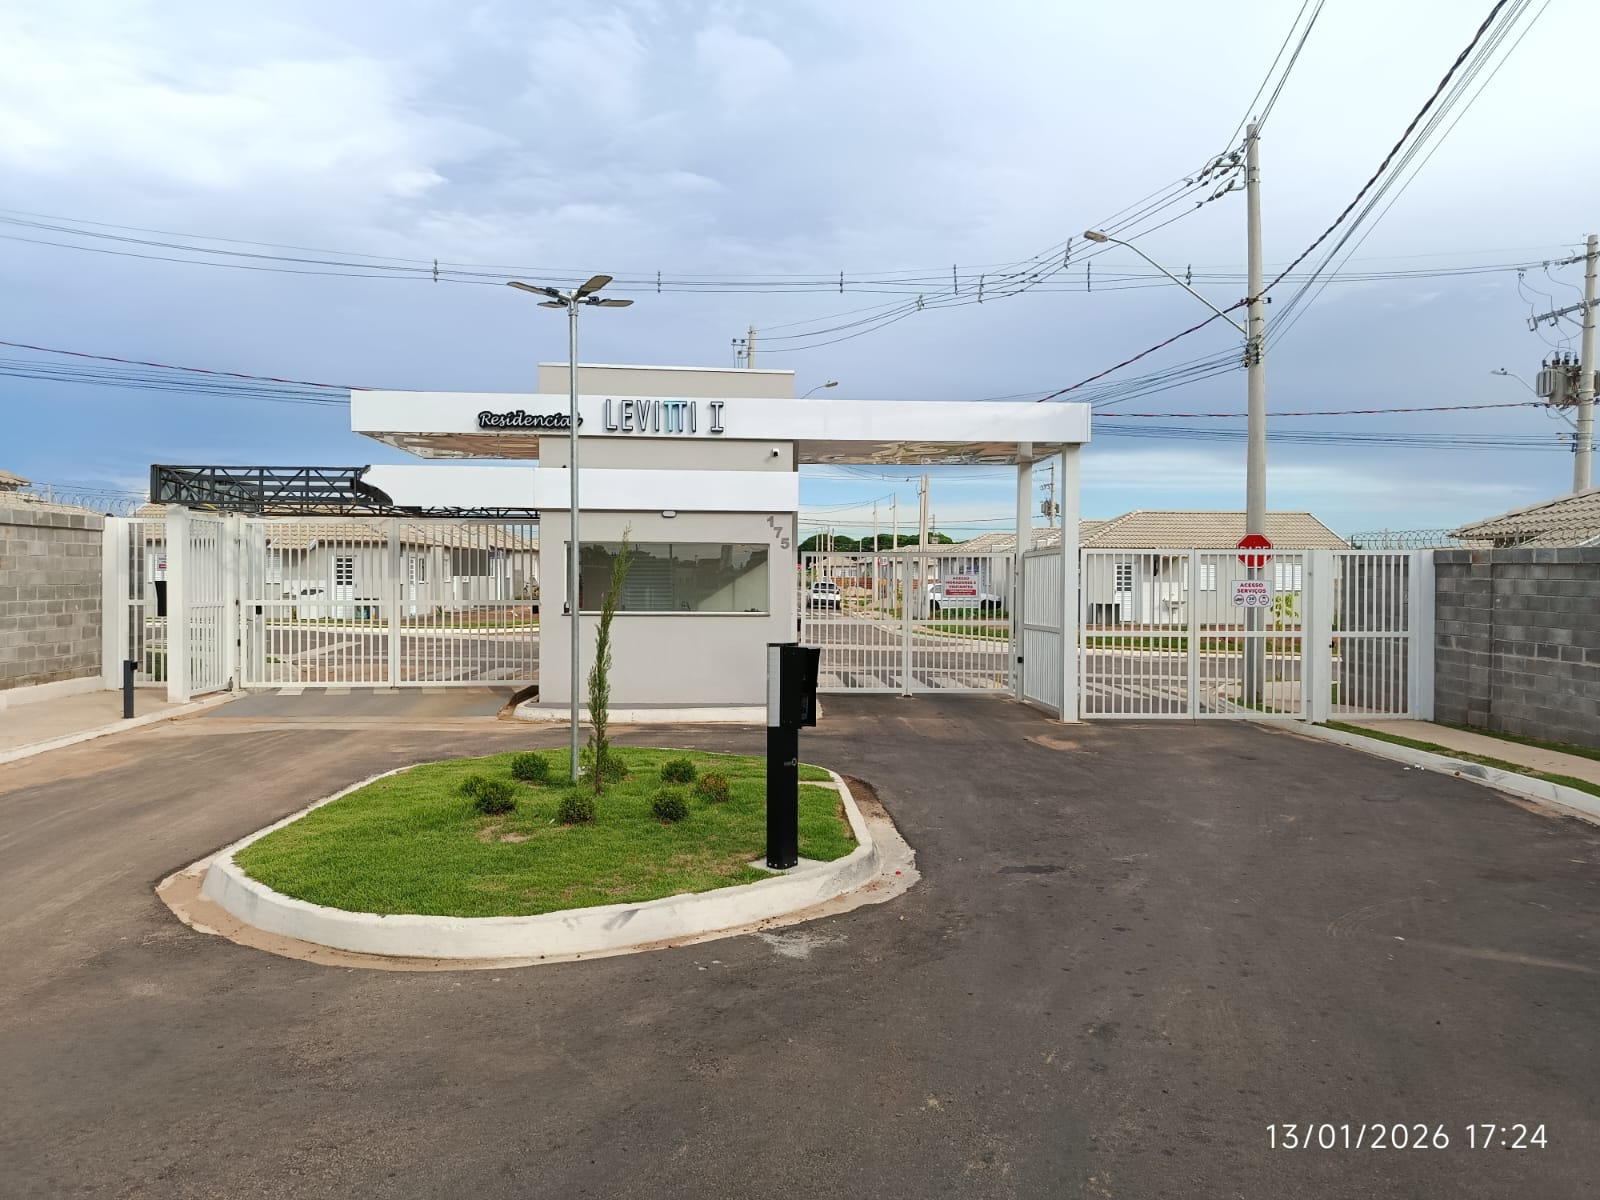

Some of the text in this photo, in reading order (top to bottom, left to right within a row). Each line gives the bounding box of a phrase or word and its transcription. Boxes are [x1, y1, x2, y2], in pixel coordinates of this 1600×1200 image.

[604, 399, 697, 432] LEVITTI
[710, 401, 724, 433] I
[766, 515, 790, 550] 175
